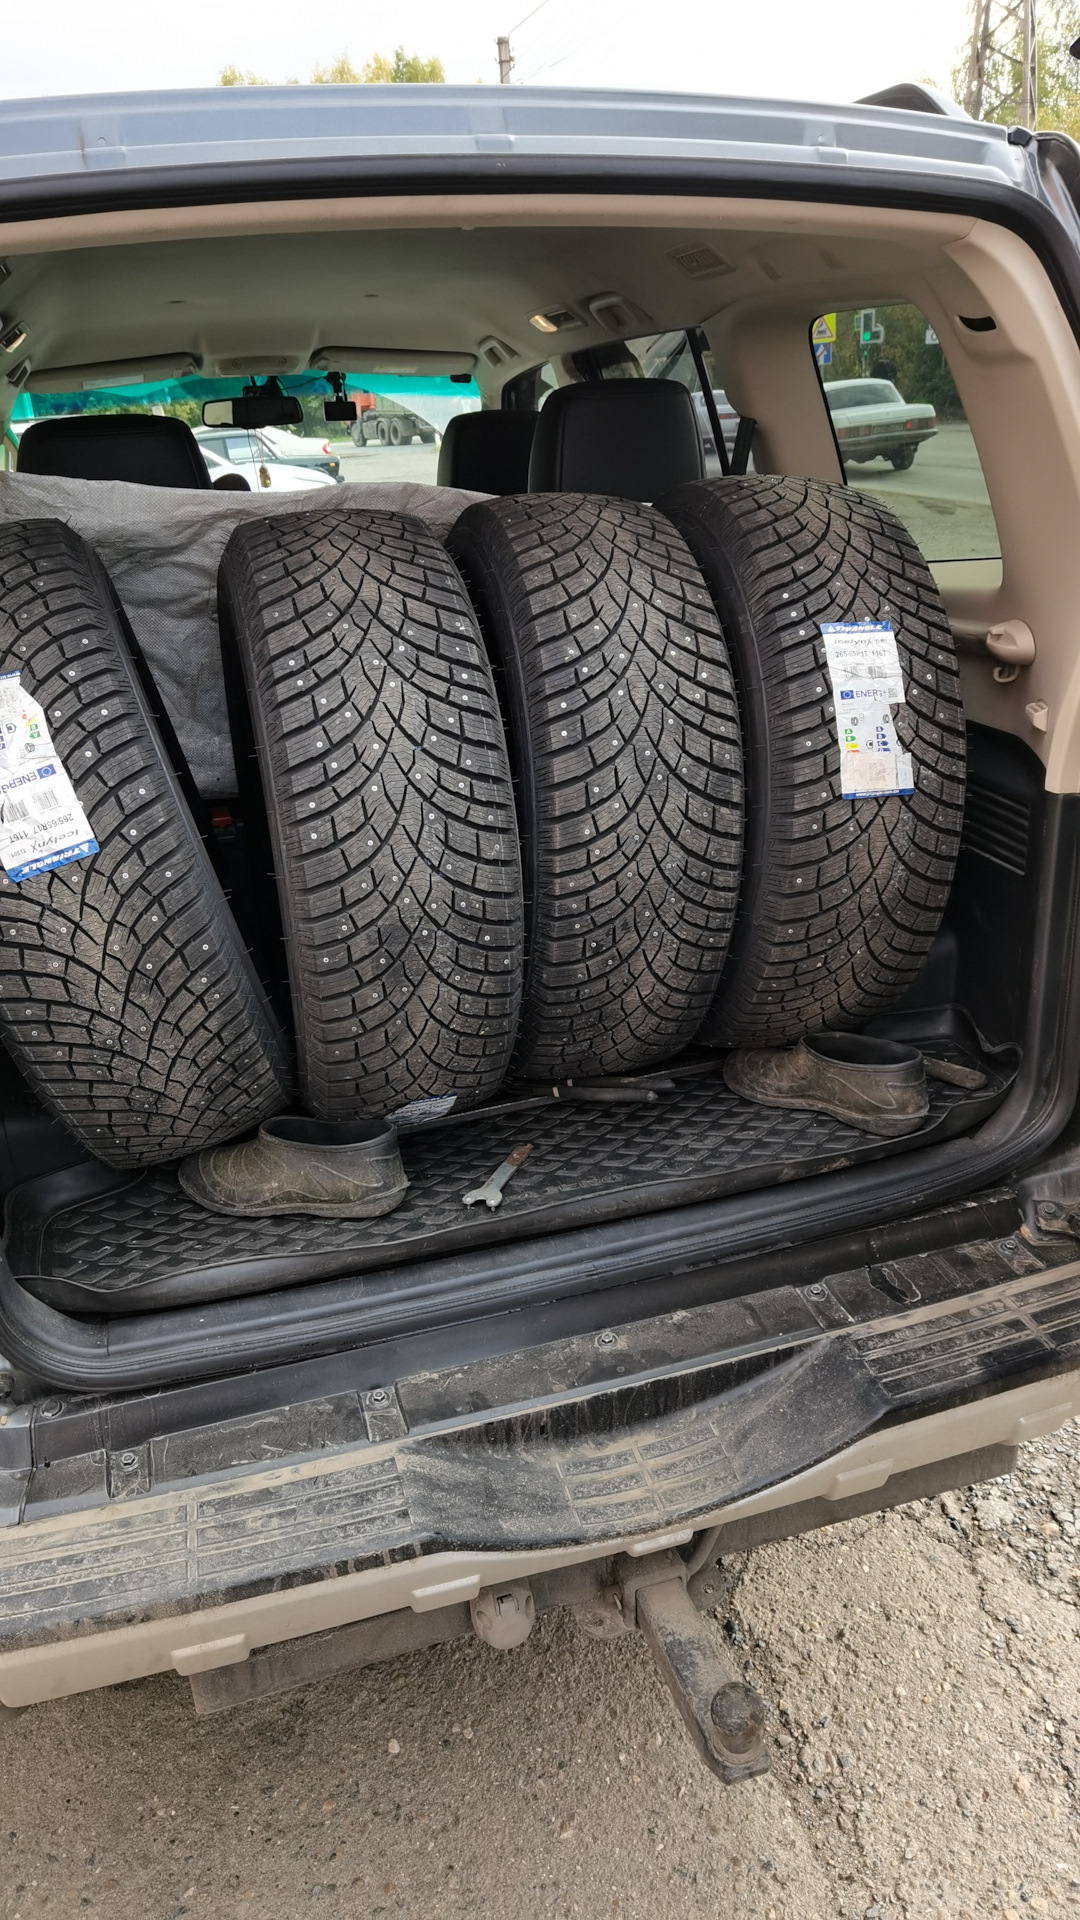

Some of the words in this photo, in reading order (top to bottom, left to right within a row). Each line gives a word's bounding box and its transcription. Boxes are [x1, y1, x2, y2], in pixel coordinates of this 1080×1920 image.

[33, 813, 74, 834] 265/65R17
[9, 830, 28, 844] 116T
[21, 847, 81, 874] TRIANGLE
